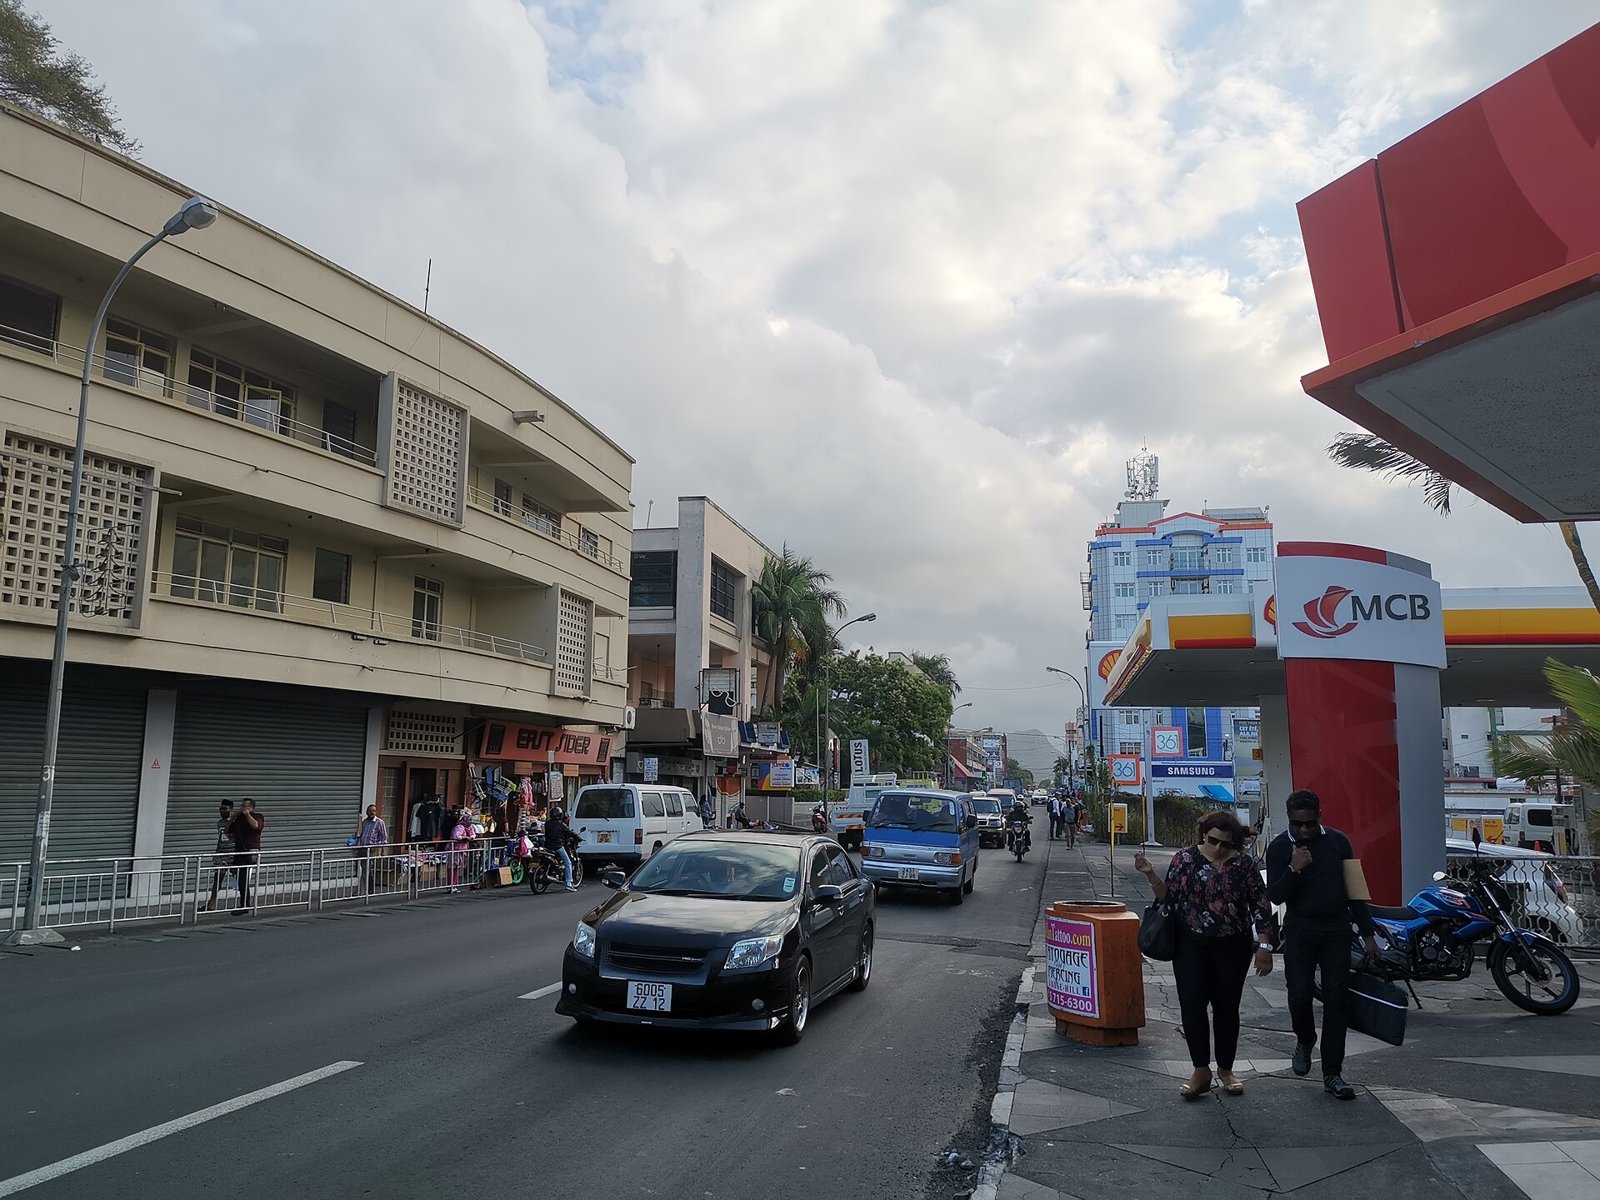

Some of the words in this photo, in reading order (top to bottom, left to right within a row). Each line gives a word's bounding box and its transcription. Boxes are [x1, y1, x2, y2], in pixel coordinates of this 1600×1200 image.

[1351, 594, 1431, 621] MCB
[517, 728, 555, 751] EAST
[554, 733, 591, 755] SIDER
[1156, 734, 1179, 750] 361
[1113, 761, 1136, 778] 361
[1167, 766, 1216, 776] SAMSUNG
[636, 983, 665, 997] 6005
[633, 995, 647, 1009] ZZ
[653, 997, 666, 1011] 12
[1049, 991, 1092, 1011] 5715-6300
